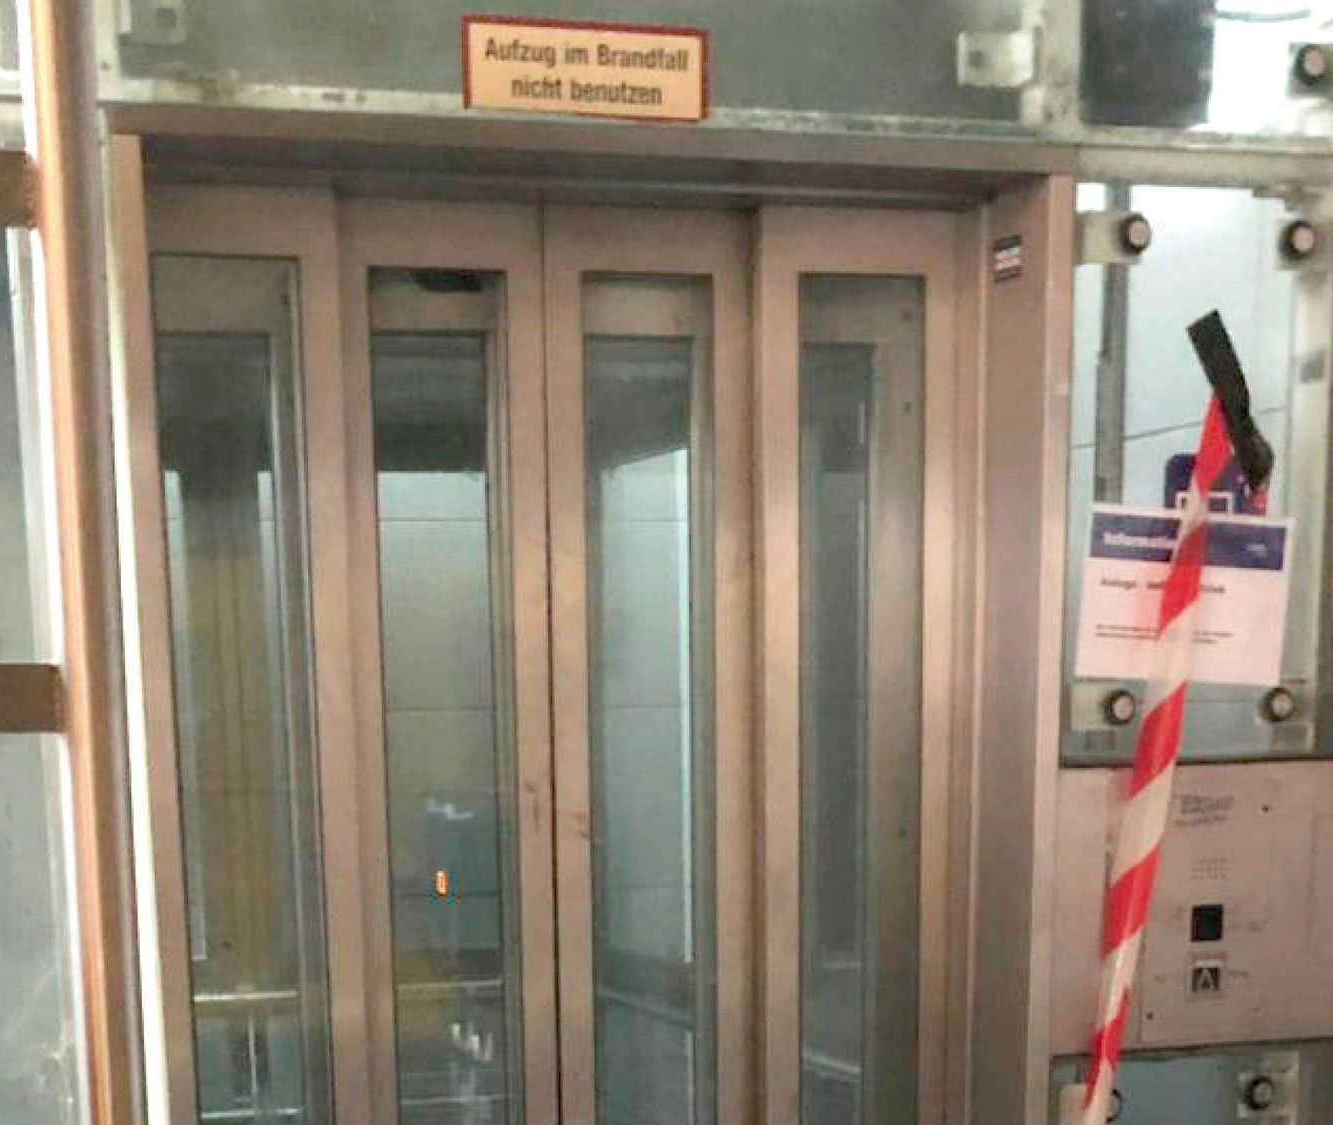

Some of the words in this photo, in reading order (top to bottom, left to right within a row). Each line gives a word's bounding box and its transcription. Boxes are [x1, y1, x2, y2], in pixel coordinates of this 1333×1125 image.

[485, 37, 557, 68] Aufzug
[564, 41, 589, 66] im
[597, 43, 689, 71] Brandfall
[511, 76, 562, 100] nicht
[570, 77, 663, 105] benutzen
